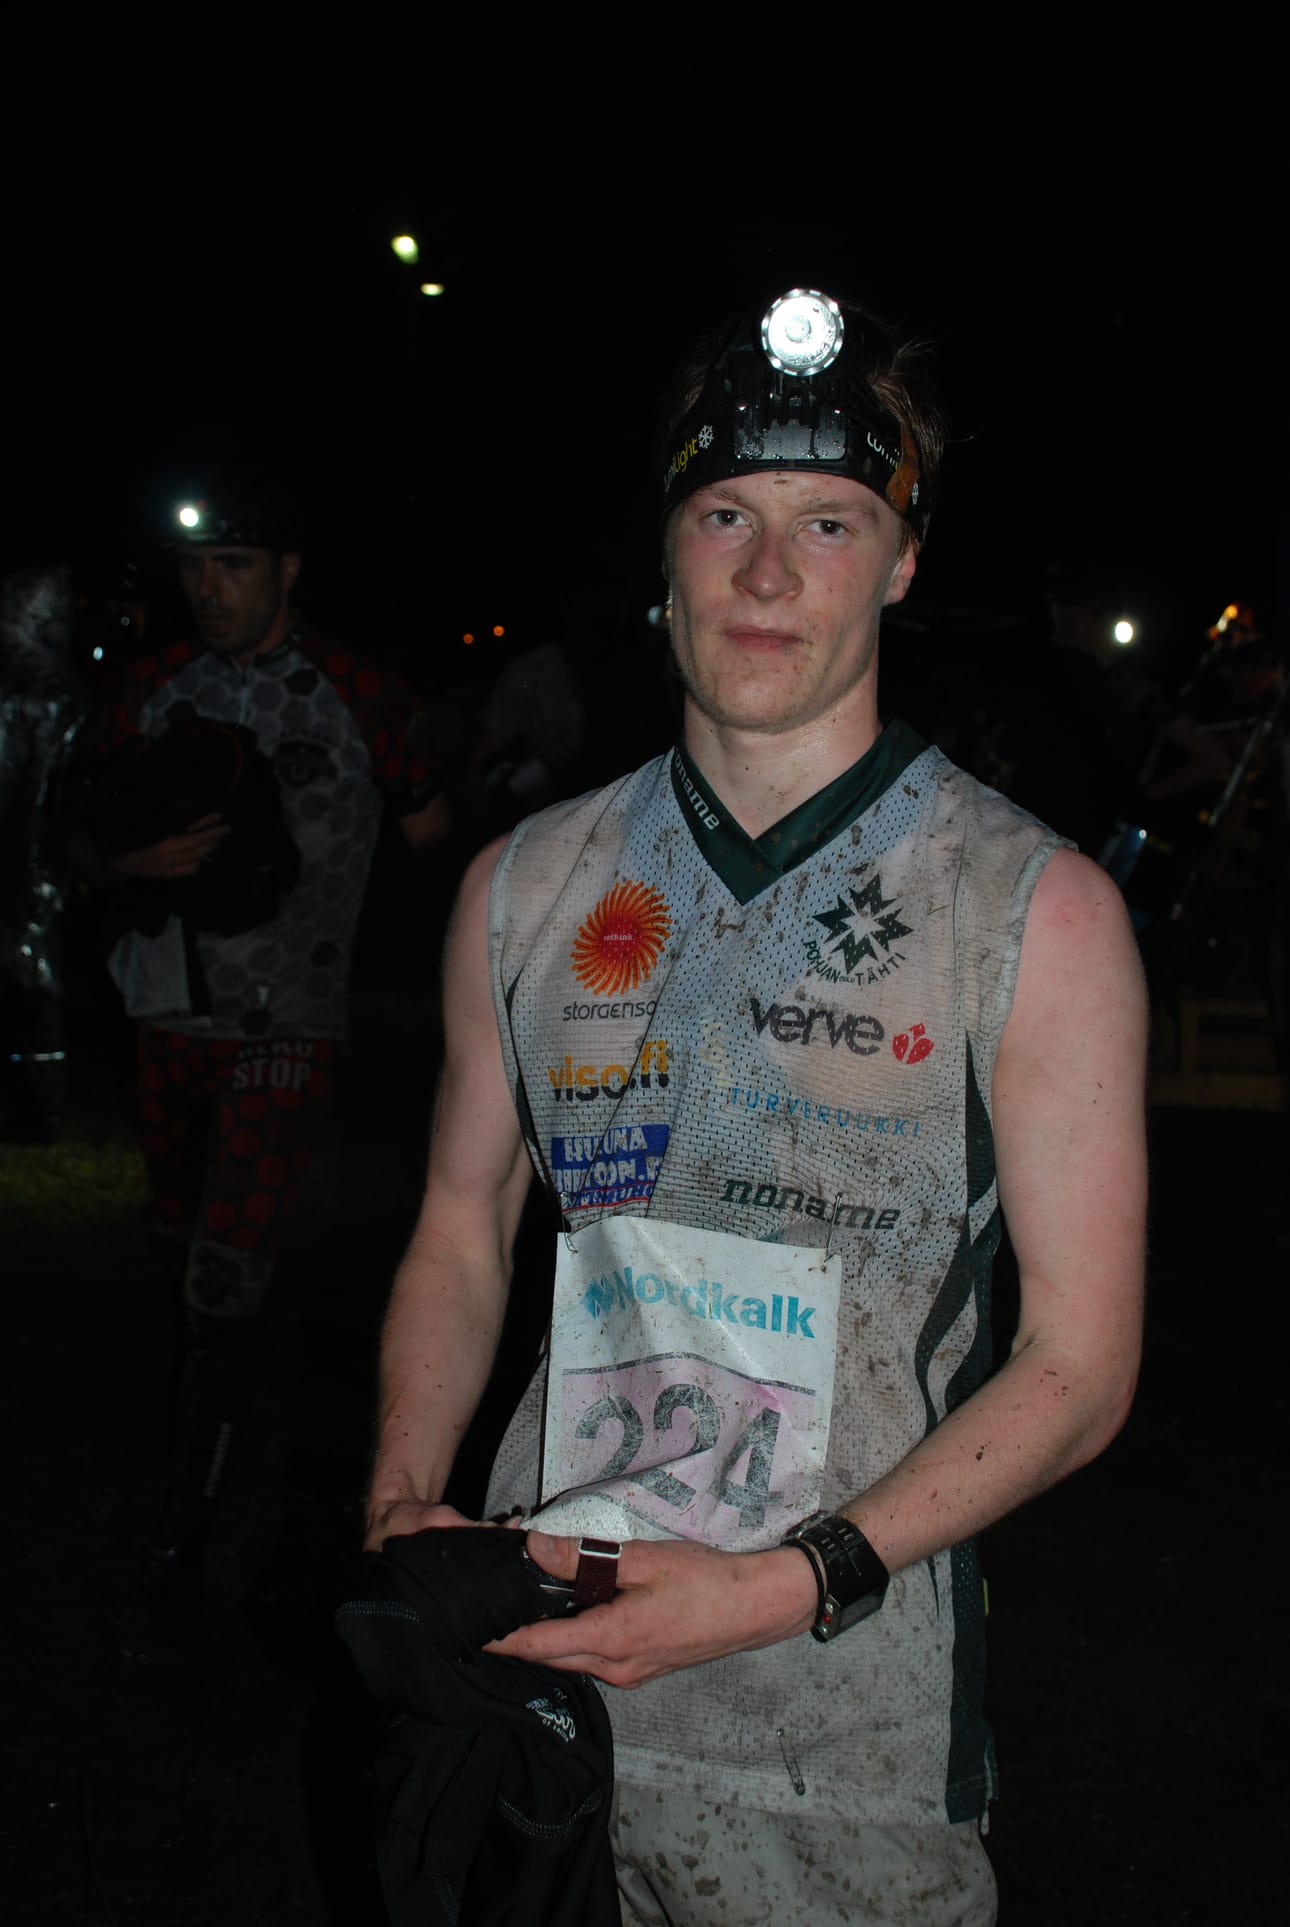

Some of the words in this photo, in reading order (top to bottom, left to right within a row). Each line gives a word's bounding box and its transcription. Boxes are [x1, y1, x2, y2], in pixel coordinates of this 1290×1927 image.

[674, 752, 720, 830] oname
[855, 952, 906, 986] TÄHTI
[750, 997, 885, 1056] verve
[232, 1057, 312, 1092] STOP
[547, 1039, 670, 1102] viso.fi
[731, 1087, 922, 1138] TURVERUUKKI
[719, 1178, 901, 1230] noname
[612, 1266, 817, 1339] Nordkalk
[574, 1383, 785, 1529] 224
